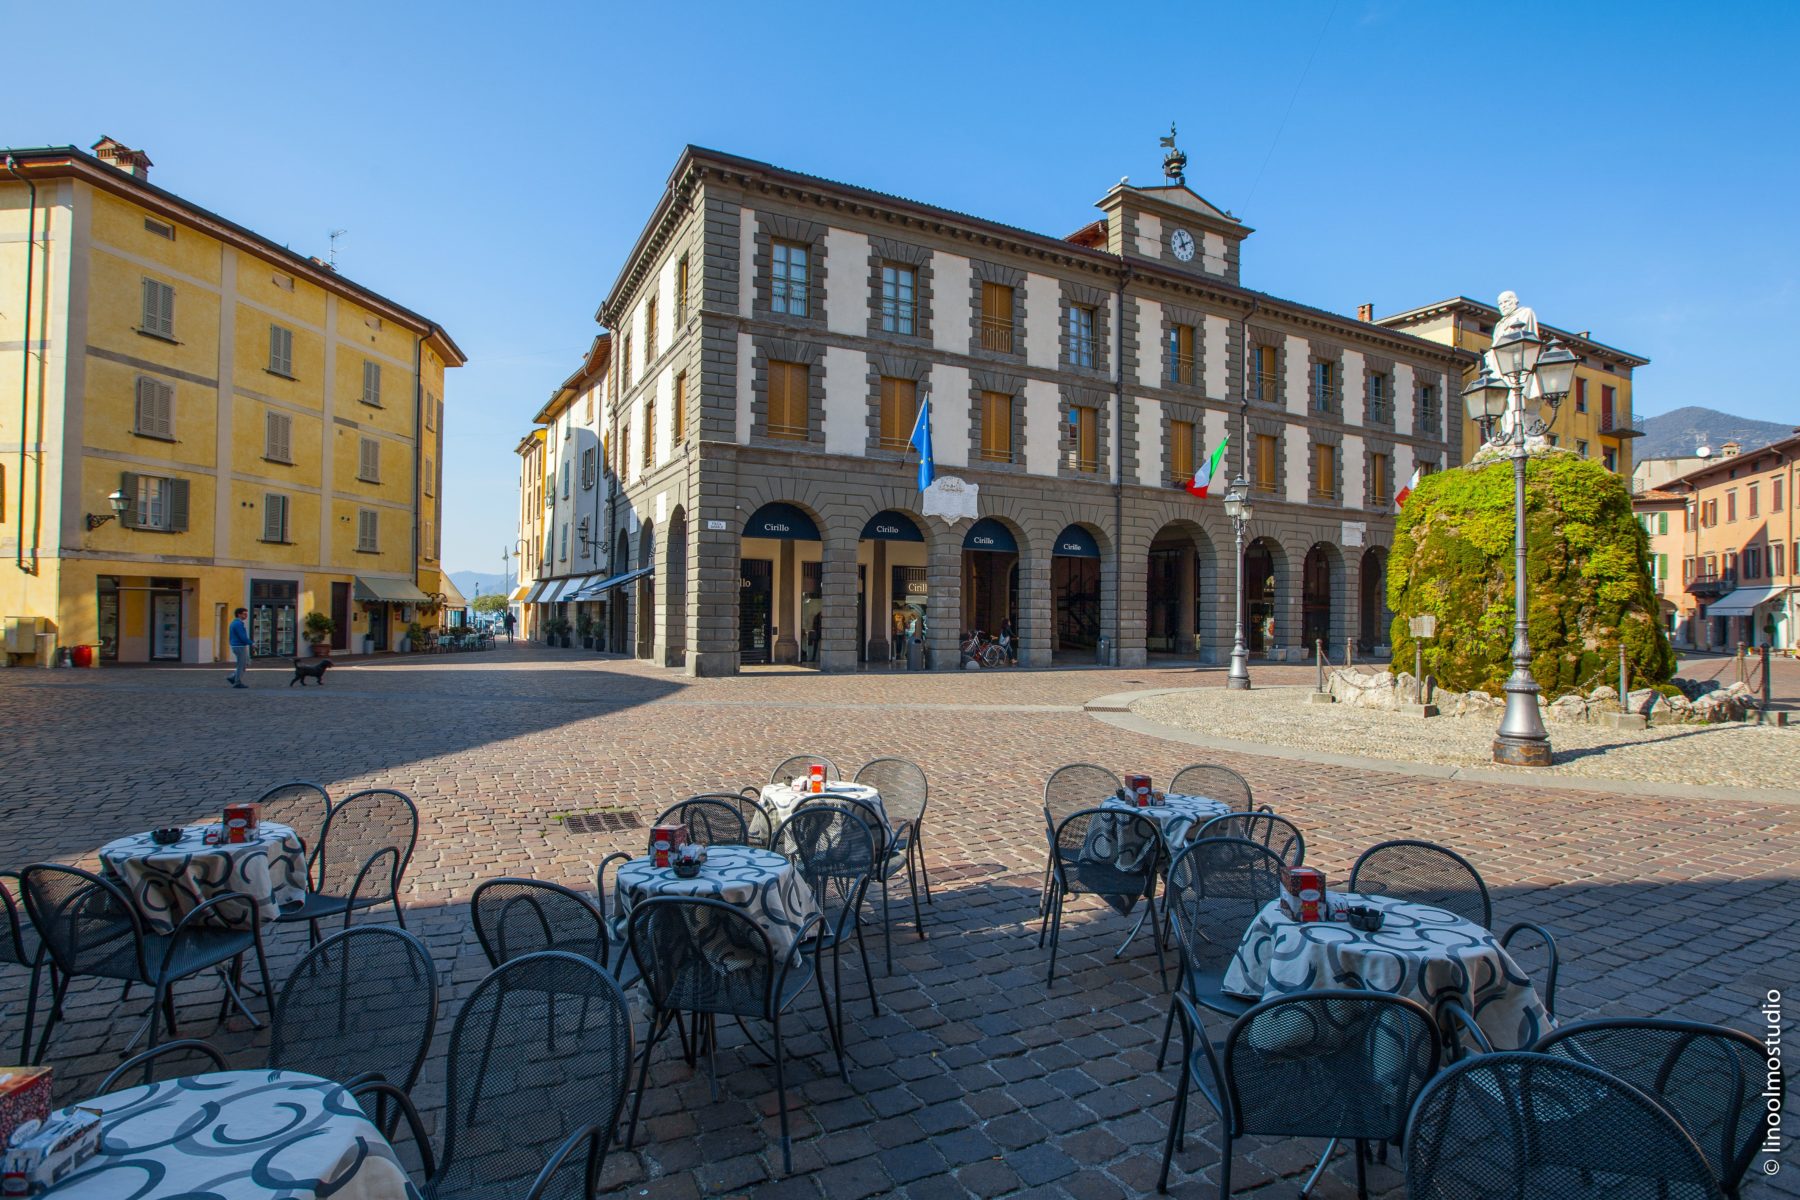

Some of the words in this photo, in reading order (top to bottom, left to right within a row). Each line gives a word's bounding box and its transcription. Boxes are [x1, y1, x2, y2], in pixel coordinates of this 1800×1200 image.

[764, 523, 790, 532] Cirillo
[876, 525, 899, 534] Cirillo
[973, 537, 994, 545] Cirillo
[1063, 543, 1082, 551] Cirillo
[739, 578, 751, 588] llo
[908, 583, 928, 592] Cirill
